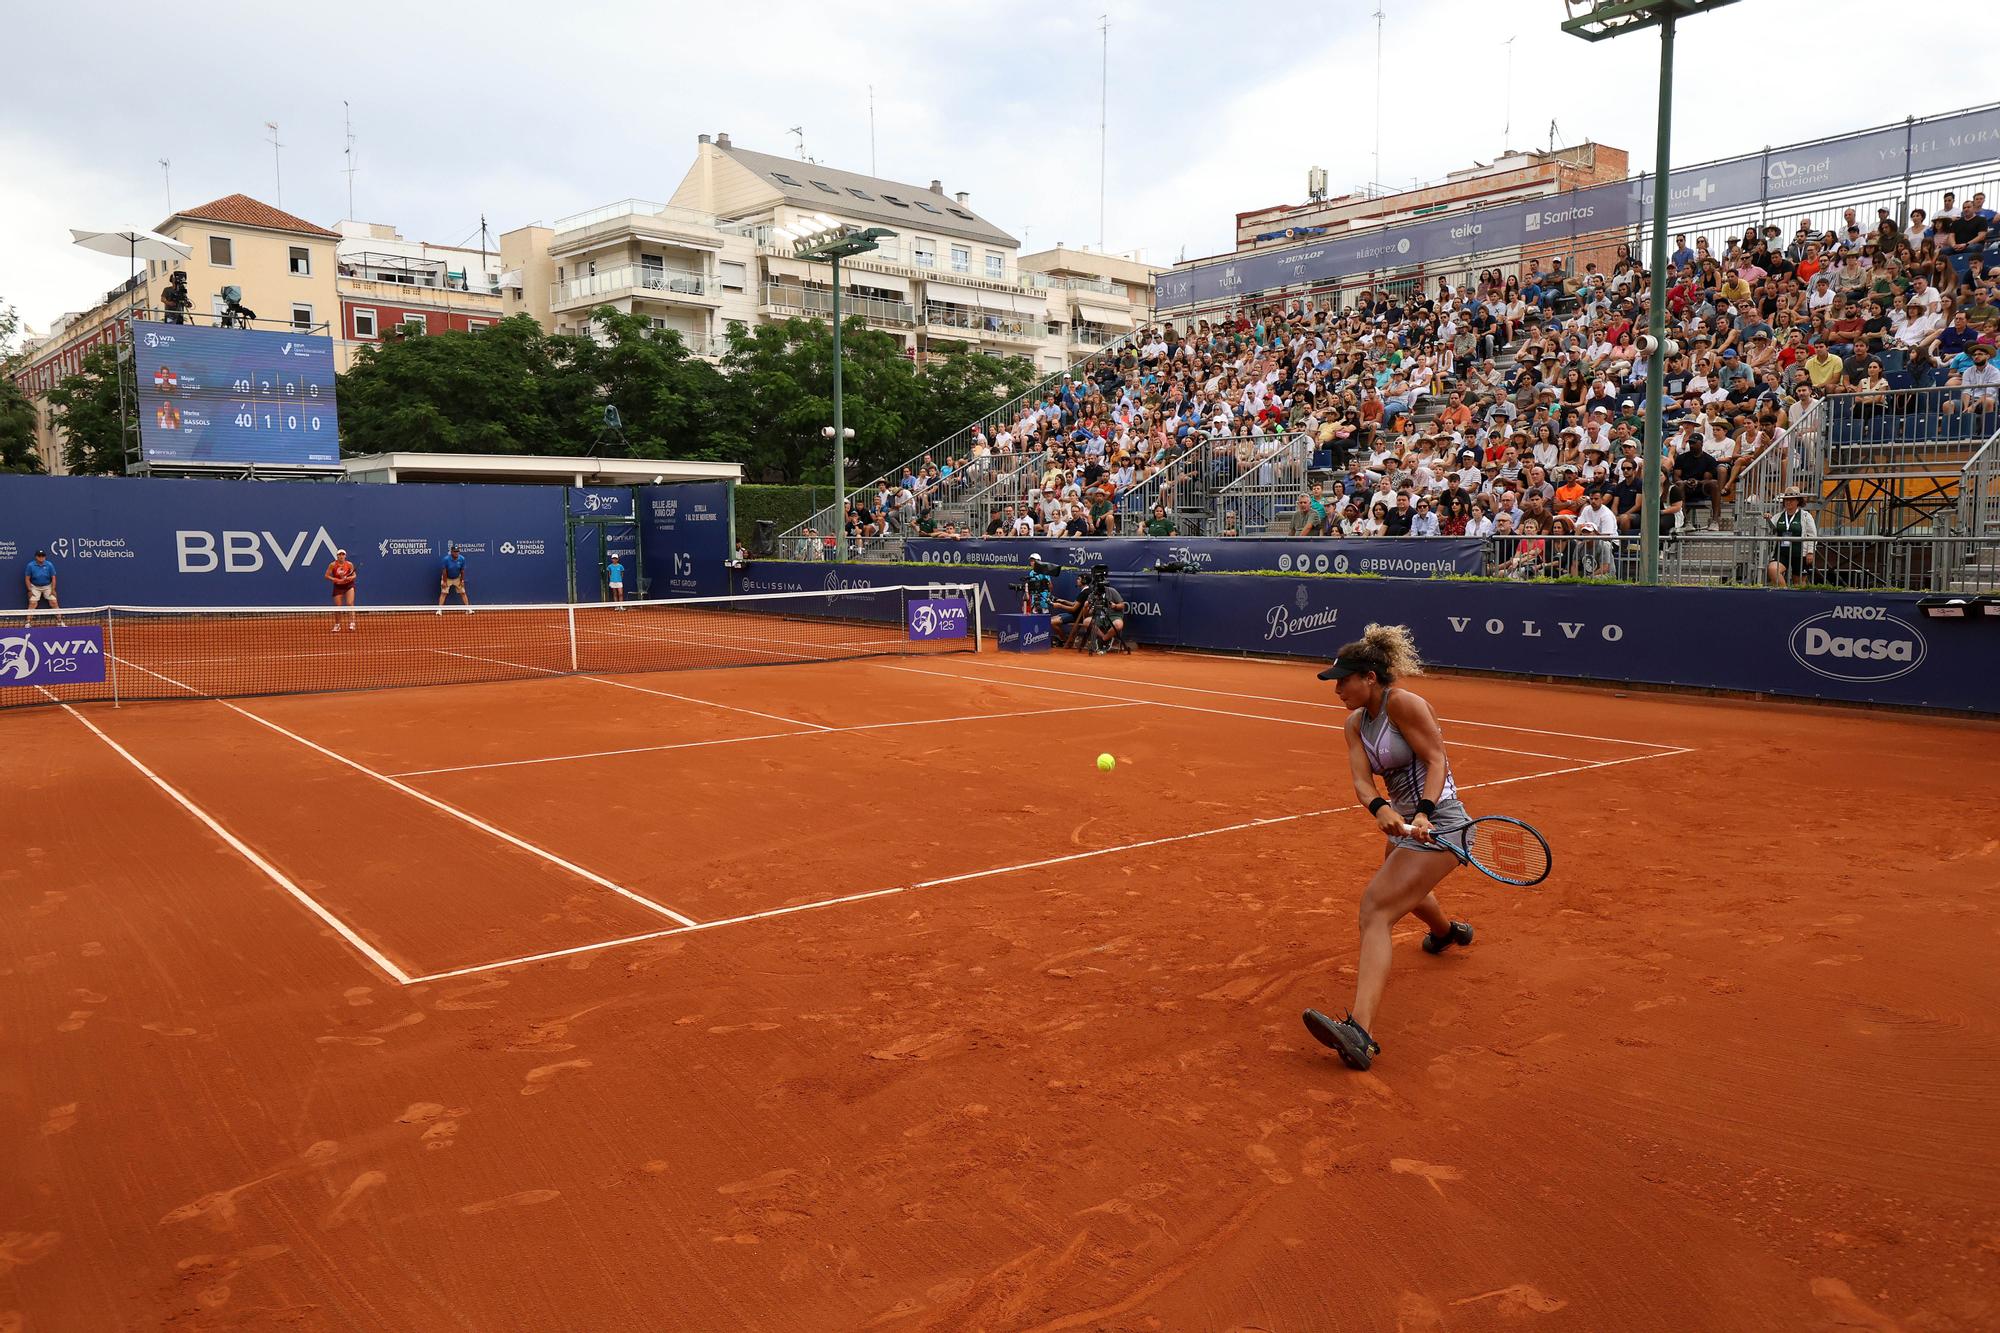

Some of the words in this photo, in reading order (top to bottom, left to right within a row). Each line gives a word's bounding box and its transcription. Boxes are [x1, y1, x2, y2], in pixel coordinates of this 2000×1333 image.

[1769, 173, 1829, 191] soluciones
[1543, 205, 1594, 226] Sanitas
[1450, 223, 1482, 239] teika
[1285, 251, 1325, 264] DUNLOP
[1219, 275, 1242, 288] TURIA
[233, 379, 250, 393] 40
[262, 381, 270, 394] 2
[235, 413, 252, 428] 40
[264, 414, 271, 429] 1
[288, 416, 297, 430] 0
[311, 417, 320, 431] 0
[654, 508, 666, 517] KING
[666, 508, 676, 517] CUP
[78, 537, 126, 549] Diputació
[175, 525, 338, 573] BBVA
[79, 549, 91, 559] de
[92, 549, 135, 559] València
[966, 551, 1019, 565] @BBVAOpenVal
[1087, 551, 1103, 561] WTA
[1192, 552, 1212, 562] WTA
[1360, 558, 1456, 574] @BBVAOpenVal
[681, 579, 697, 588] GROUP
[938, 608, 965, 619] WTA
[1122, 600, 1162, 616] DROLA
[1831, 605, 1887, 621] ARROZ
[938, 620, 955, 632] 125
[1264, 604, 1339, 641] Beronia
[1447, 616, 1624, 642] VOLVO
[42, 639, 99, 655] WTA
[1805, 627, 1913, 662] Dacsa
[45, 658, 77, 673] 125
